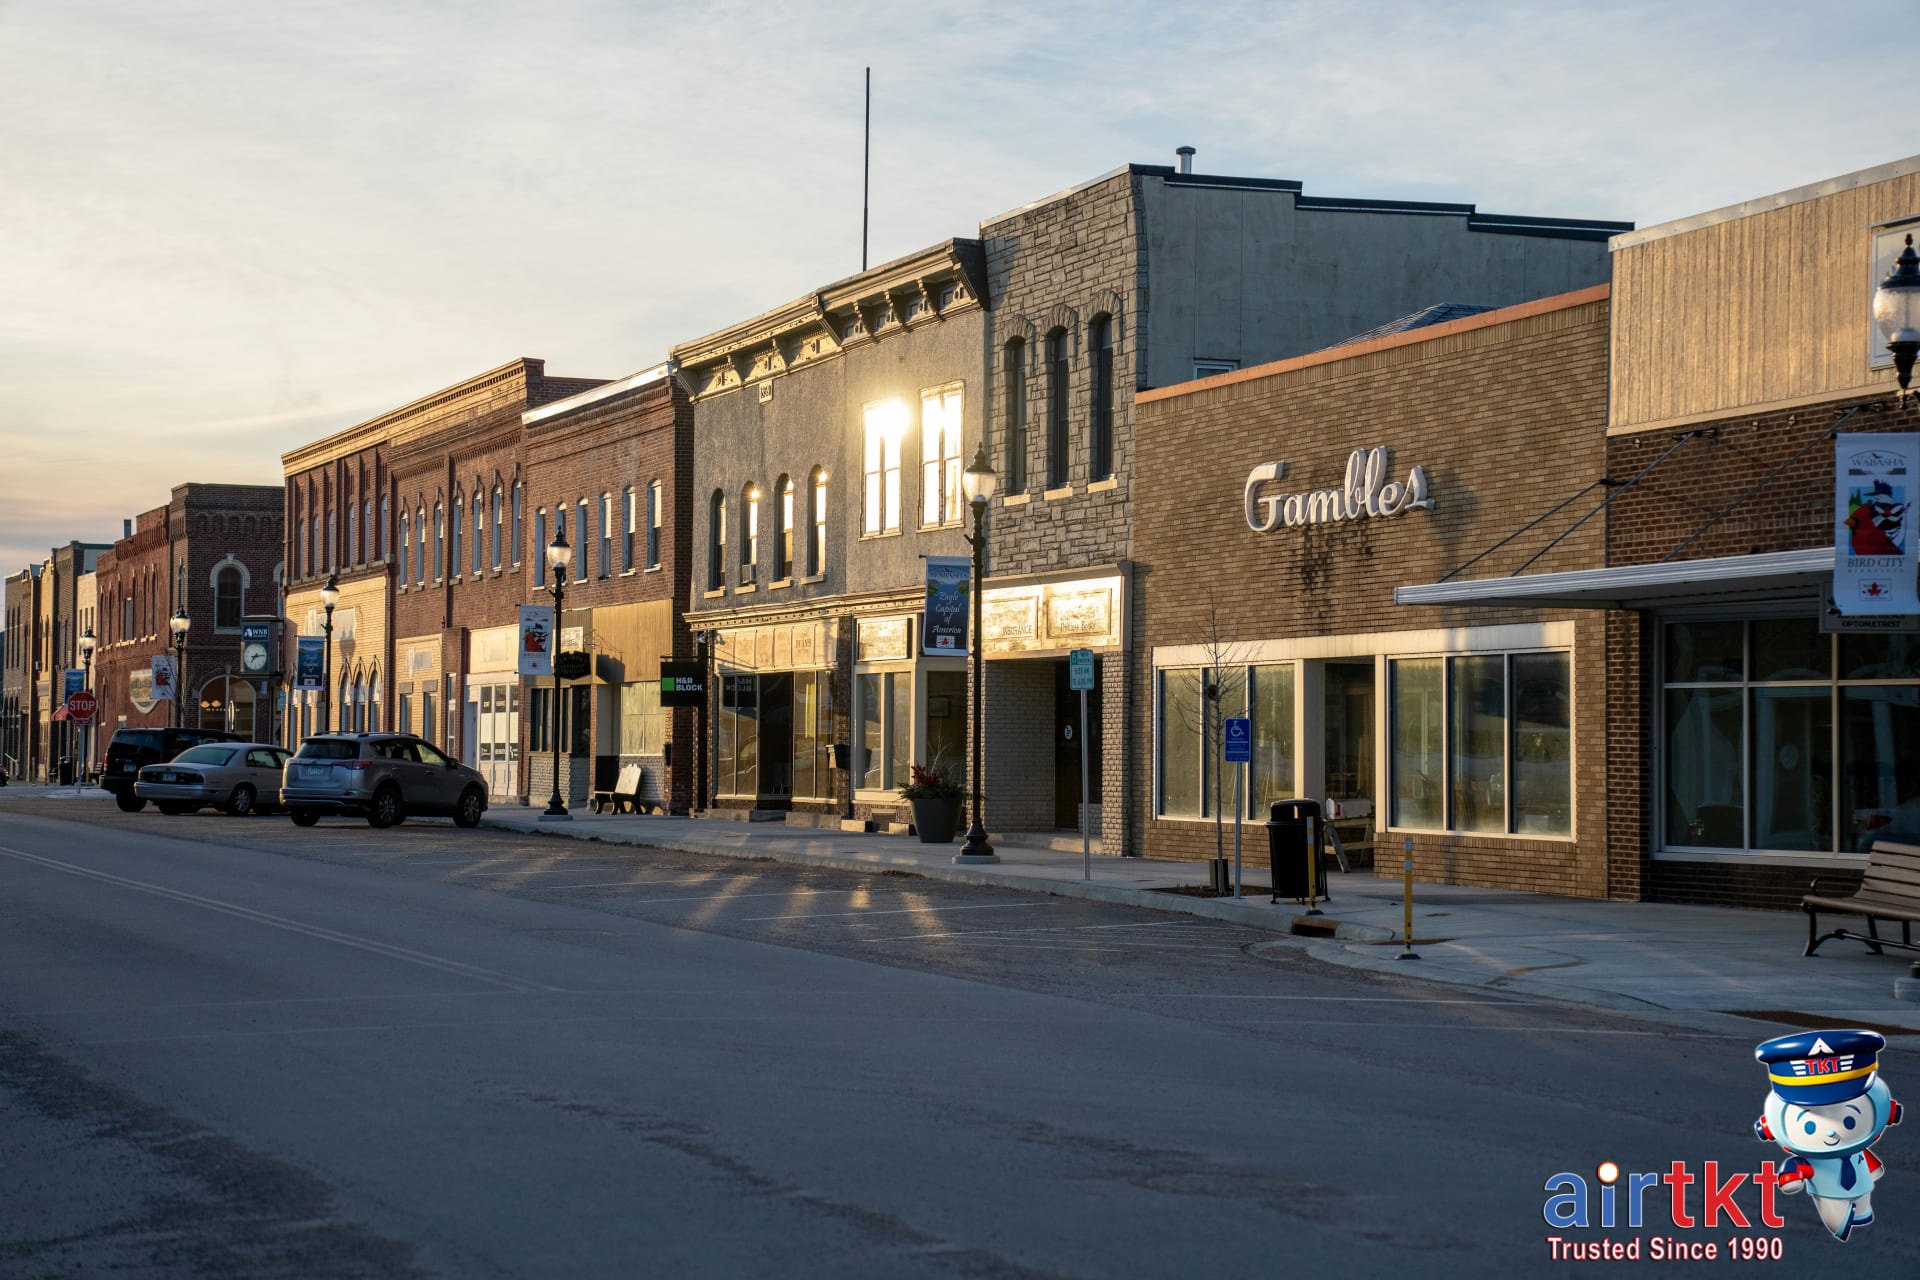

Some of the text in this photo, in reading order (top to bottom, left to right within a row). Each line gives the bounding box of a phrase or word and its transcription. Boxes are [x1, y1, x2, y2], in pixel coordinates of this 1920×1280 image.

[1852, 458, 1905, 466] WABASHA
[1244, 445, 1435, 532] Gambles
[1847, 557, 1905, 568] BIRD CITY
[939, 591, 959, 605] Eagle
[935, 603, 962, 616] Capital
[943, 613, 953, 624] of
[1841, 620, 1901, 628] OPTOMETRIST
[931, 624, 962, 634] America
[1002, 624, 1033, 636] INSURANCE
[69, 700, 96, 711] STOP
